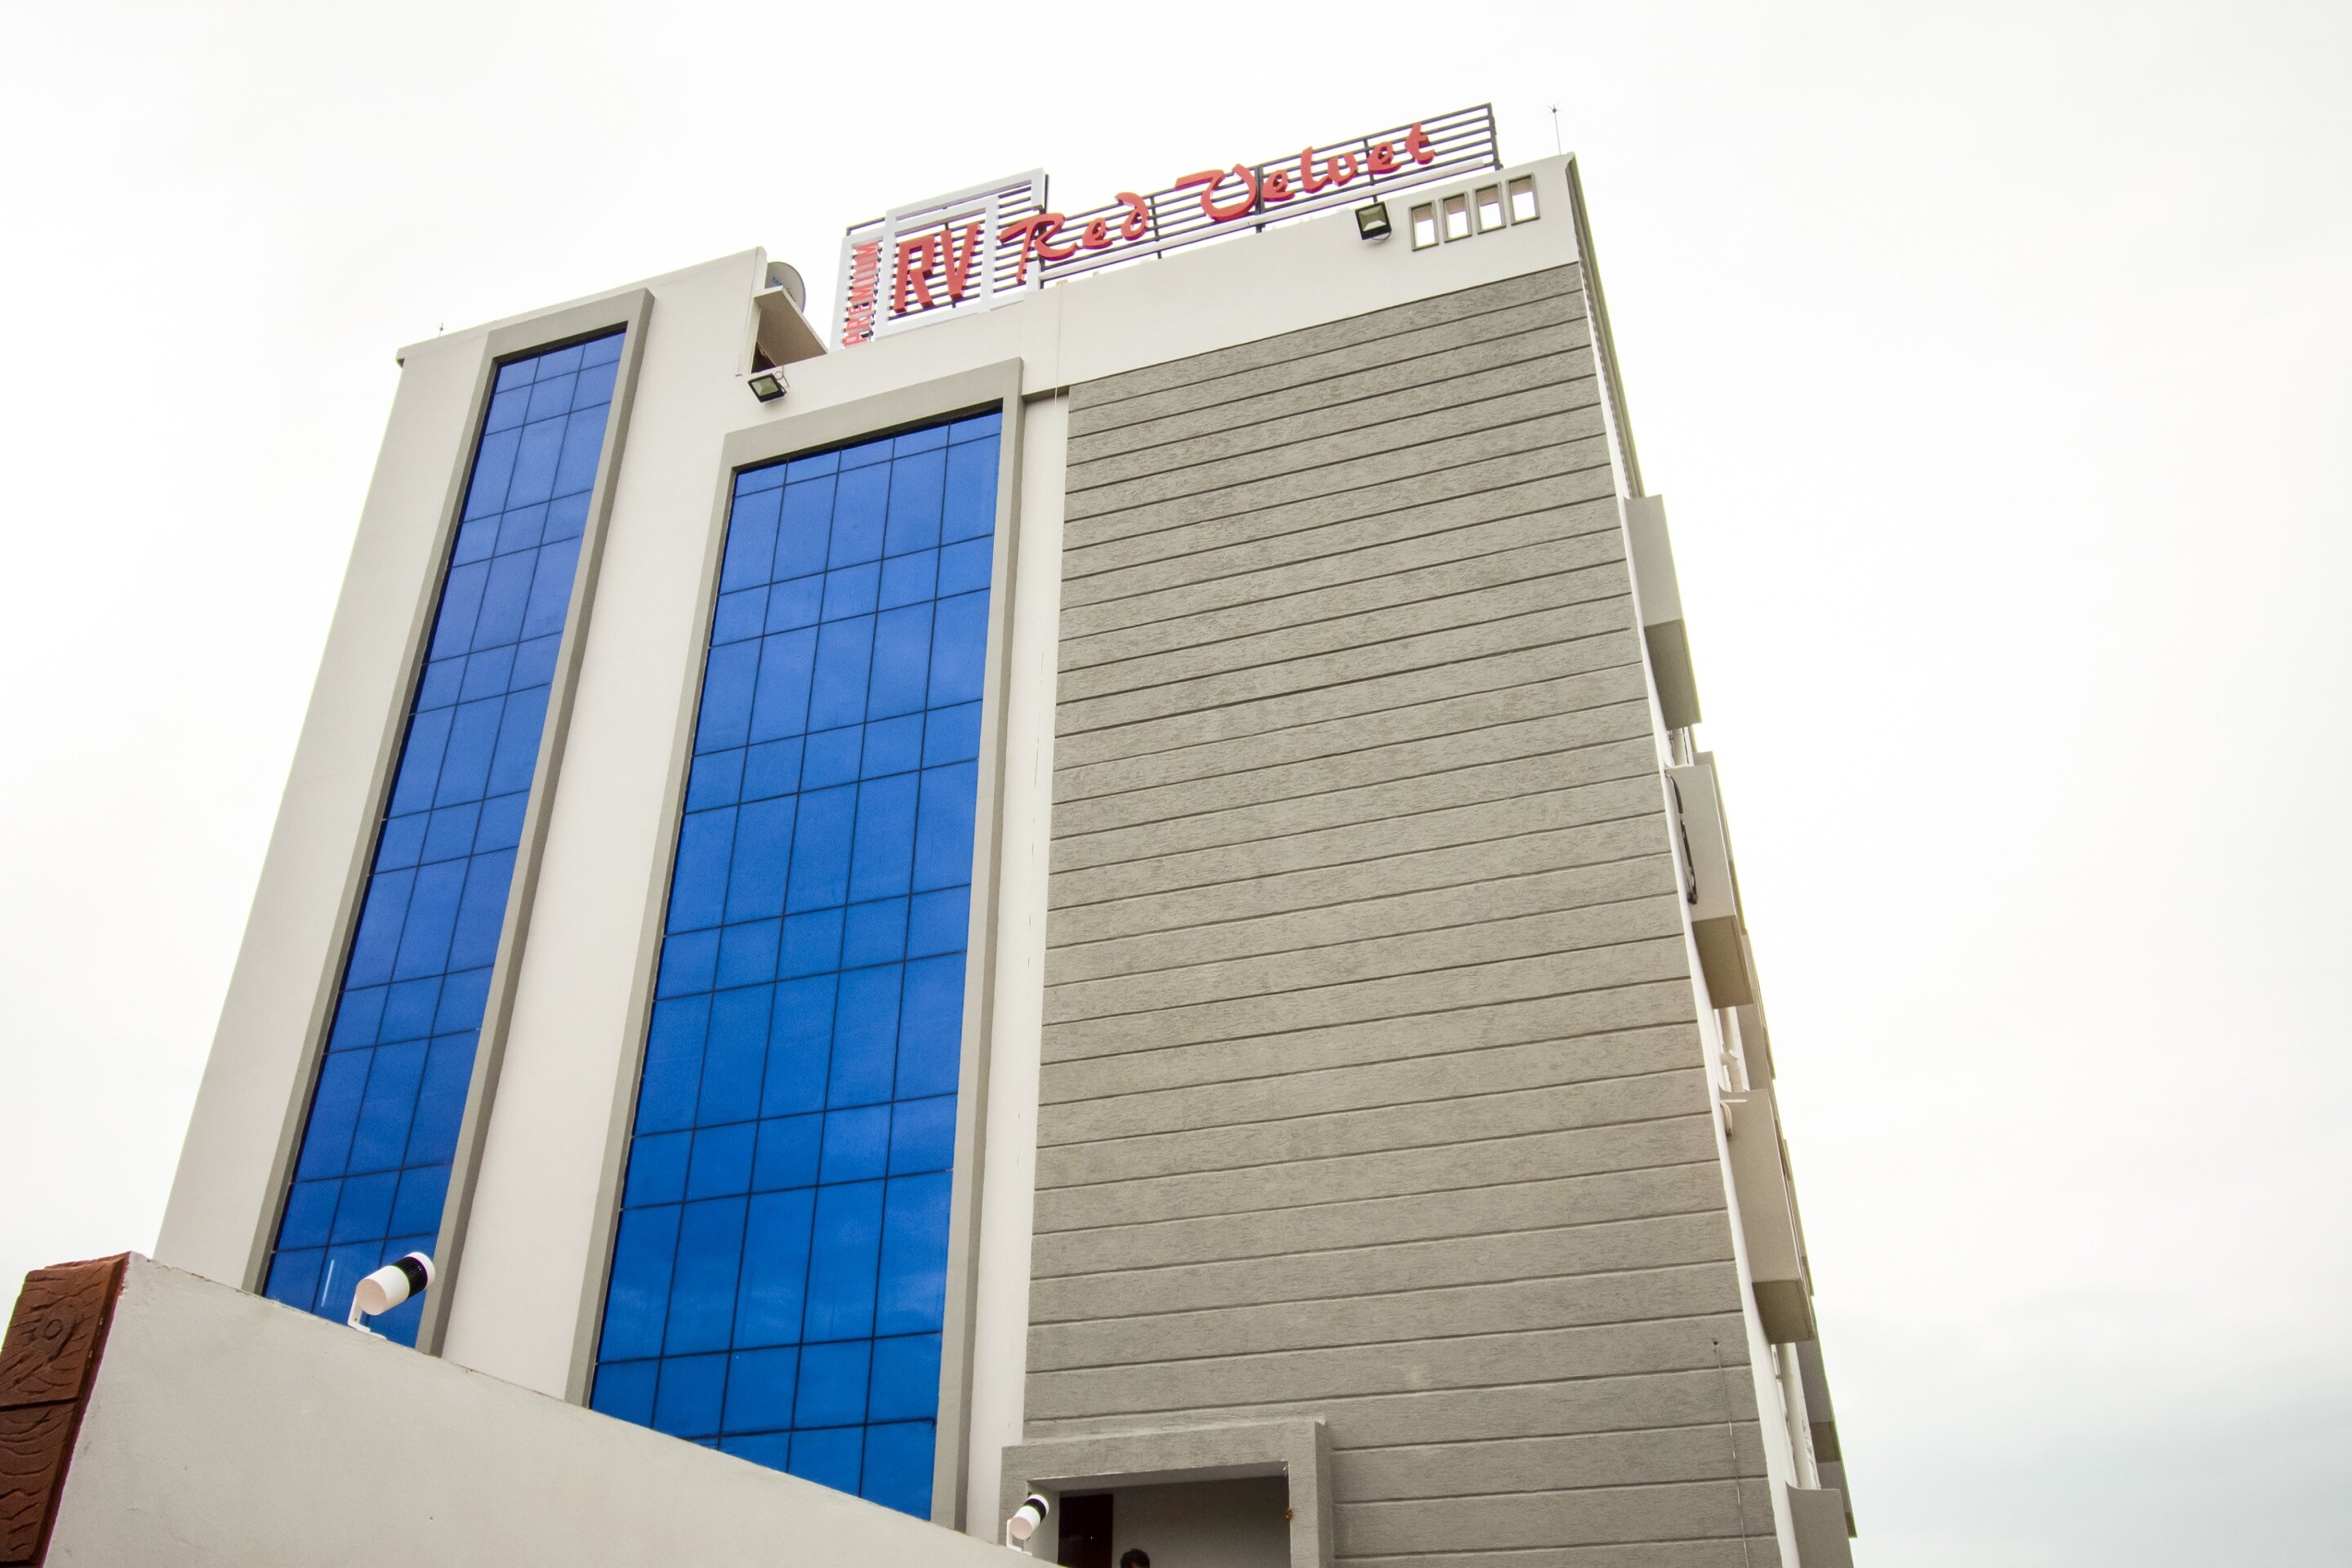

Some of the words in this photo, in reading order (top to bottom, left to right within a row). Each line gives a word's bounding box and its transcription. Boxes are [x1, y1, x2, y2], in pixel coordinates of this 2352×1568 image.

[999, 192, 1148, 283] Red
[1175, 122, 1435, 222] Velvet
[843, 241, 879, 348] PREMIUM
[893, 221, 981, 313] RV
